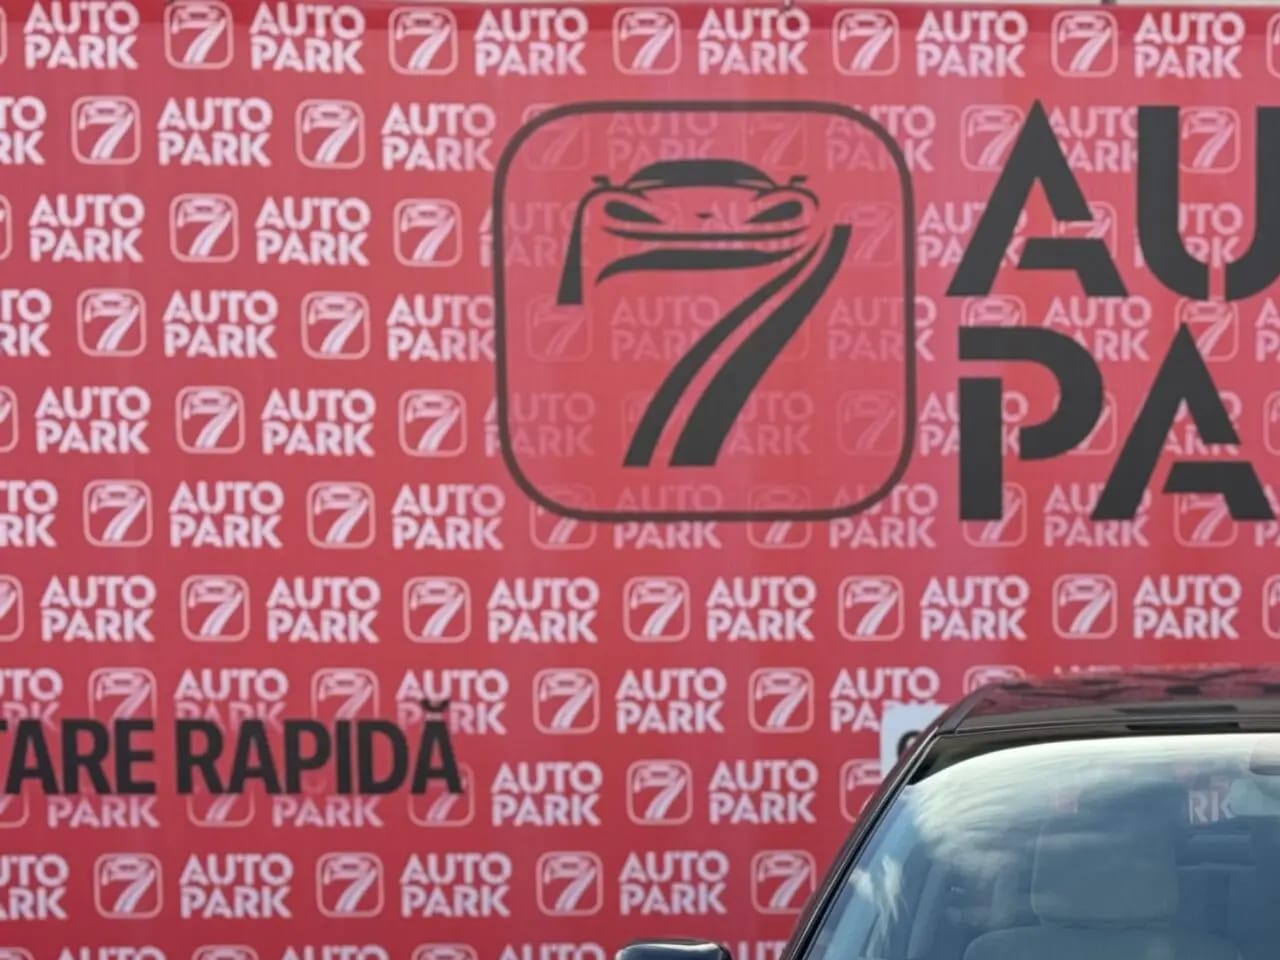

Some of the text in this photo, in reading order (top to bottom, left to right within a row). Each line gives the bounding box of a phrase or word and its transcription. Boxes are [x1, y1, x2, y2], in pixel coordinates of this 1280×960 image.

[24, 1, 138, 34] AUTO
[250, 2, 364, 37] AUTO
[476, 10, 586, 41] AUTO
[699, 9, 808, 40] AUTO
[917, 11, 1025, 42] AUTO
[1135, 12, 1242, 44] AUTO
[25, 35, 138, 69] PARK
[251, 38, 364, 74] PARK
[476, 42, 585, 75] PARK
[699, 41, 806, 74] PARK
[917, 44, 1024, 76] PARK
[1135, 45, 1241, 78] PARK
[157, 98, 272, 131] AUTO
[381, 103, 495, 136] AUTO
[159, 132, 271, 166] PARK
[383, 137, 493, 170] PARK
[29, 194, 145, 227] AUTO
[255, 197, 371, 230] AUTO
[30, 228, 143, 262] PARK
[256, 231, 369, 266] PARK
[163, 290, 278, 323] AUTO
[164, 324, 277, 358] PARK
[35, 386, 151, 419] AUTO
[261, 389, 376, 421] AUTO
[36, 420, 149, 454] PARK
[262, 422, 374, 456] PARK
[169, 481, 284, 514] AUTO
[392, 484, 504, 516] AUTO
[170, 515, 282, 548] PARK
[392, 517, 502, 549] PARK
[40, 575, 156, 608] AUTO
[266, 577, 381, 609] AUTO
[487, 578, 599, 609] AUTO
[706, 576, 816, 608] AUTO
[1133, 575, 1241, 606] AUTO
[41, 609, 154, 642] PARK
[267, 610, 378, 643] PARK
[488, 610, 597, 642] PARK
[707, 609, 813, 640] PARK
[1134, 607, 1238, 639] PARK
[615, 668, 726, 700] AUTO
[616, 701, 724, 733] PARK
[0, 698, 464, 795] ARE RAPIDĂ
[709, 759, 818, 791] AUTO
[710, 792, 815, 823] PARK
[179, 853, 293, 885] AUTO
[400, 852, 512, 884] AUTO
[619, 851, 729, 882] AUTO
[181, 886, 291, 918] PARK
[402, 885, 510, 916] PARK
[620, 883, 726, 914] PARK
